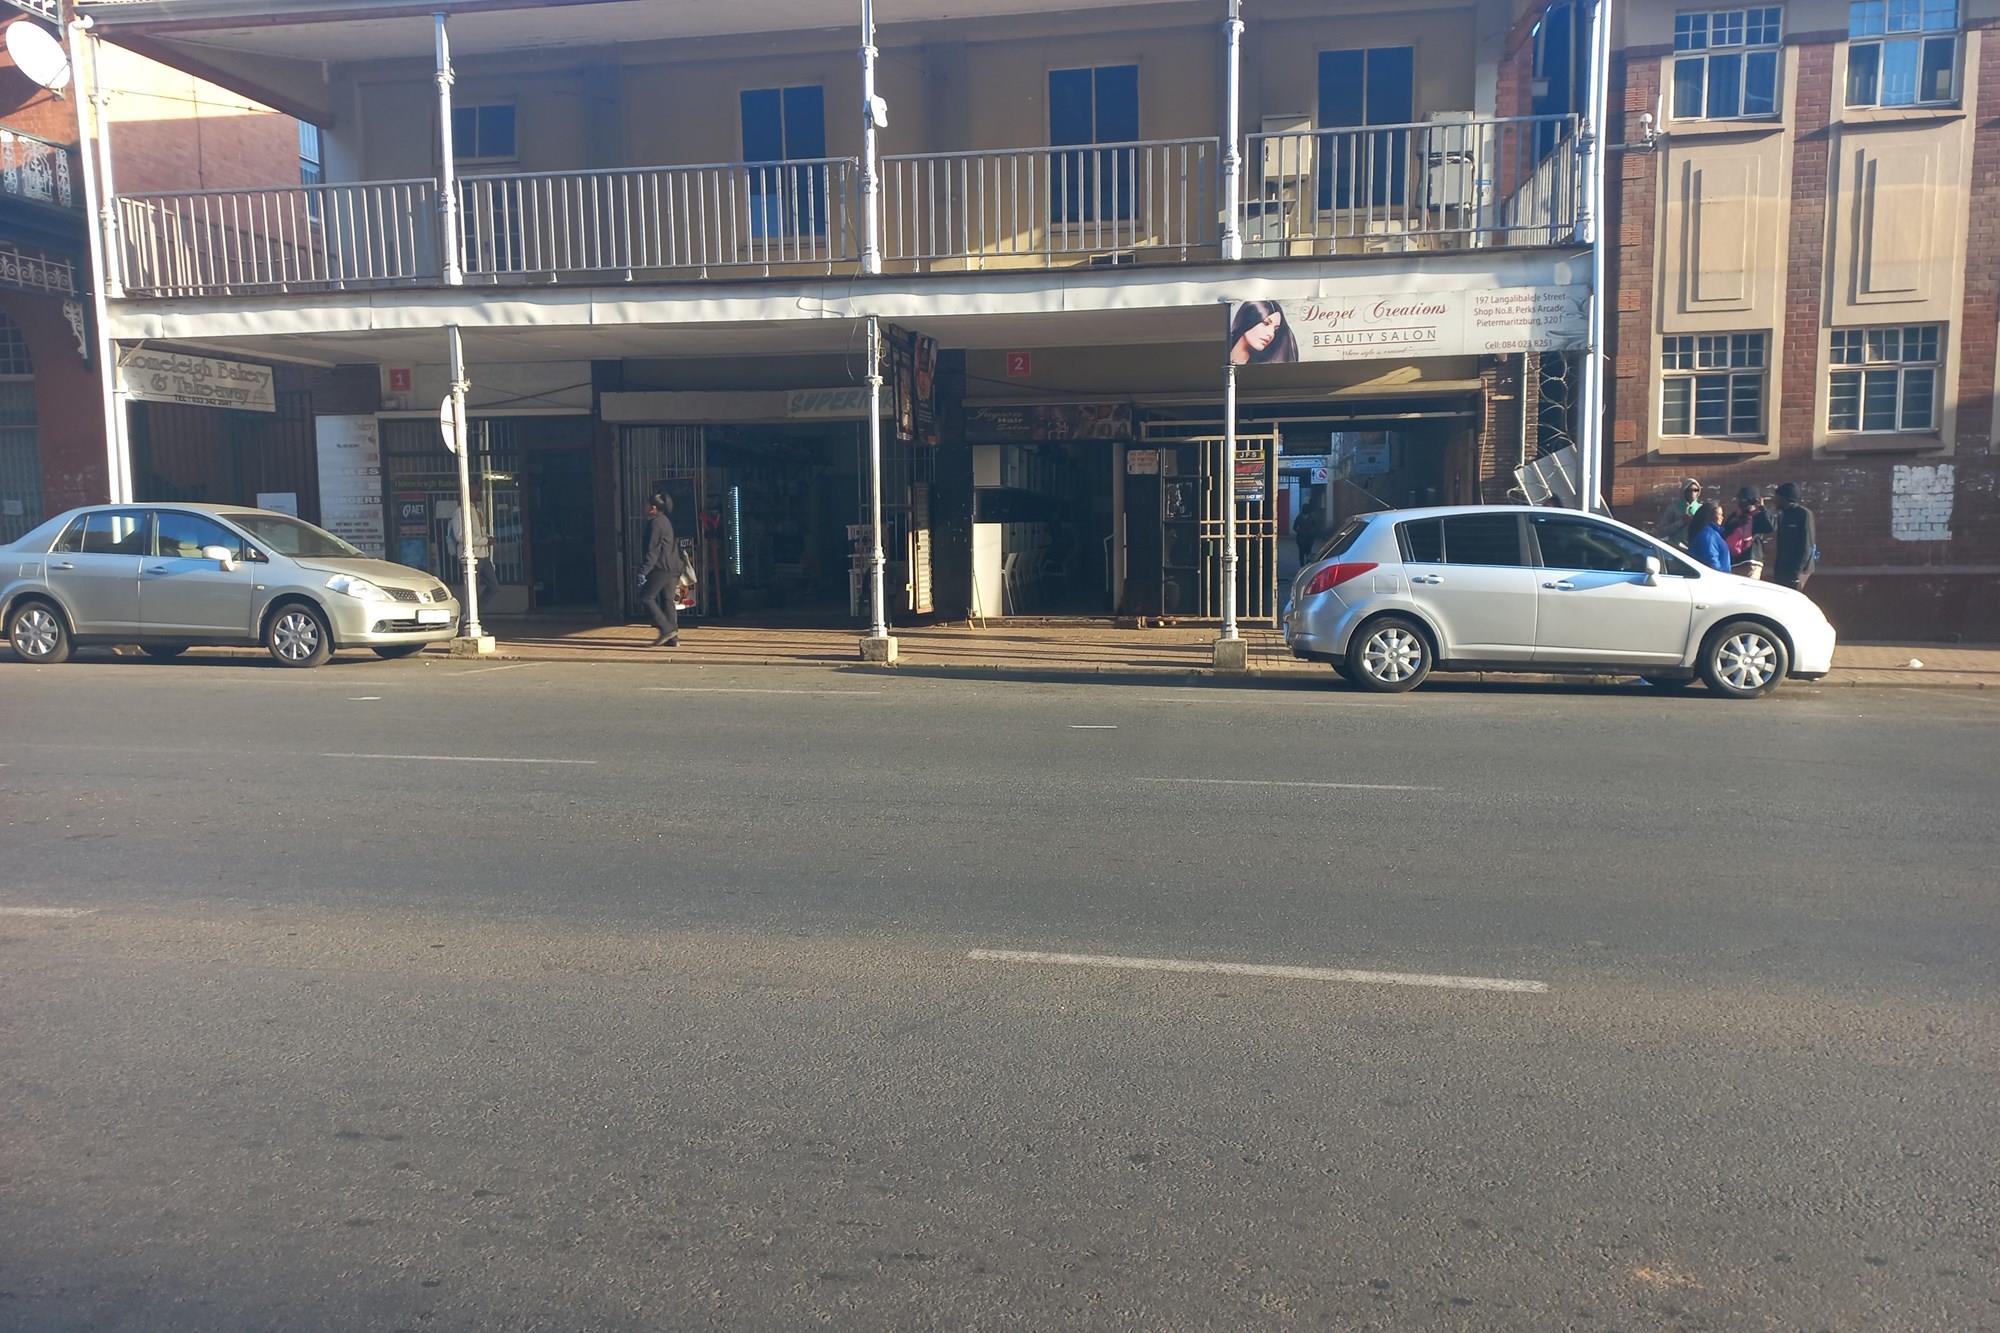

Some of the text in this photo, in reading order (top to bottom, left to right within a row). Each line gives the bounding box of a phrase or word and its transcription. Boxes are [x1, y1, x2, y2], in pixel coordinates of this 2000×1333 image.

[1475, 296, 1489, 305] 197
[1302, 299, 1448, 328] Deezet Creations
[1473, 307, 1494, 317] Shop
[1516, 304, 1536, 314] Perks
[1313, 328, 1437, 345] BEAUTY SALON
[1014, 356, 1024, 370] 2
[217, 361, 270, 388] Bakery
[397, 373, 405, 387] 1
[151, 373, 169, 392] &
